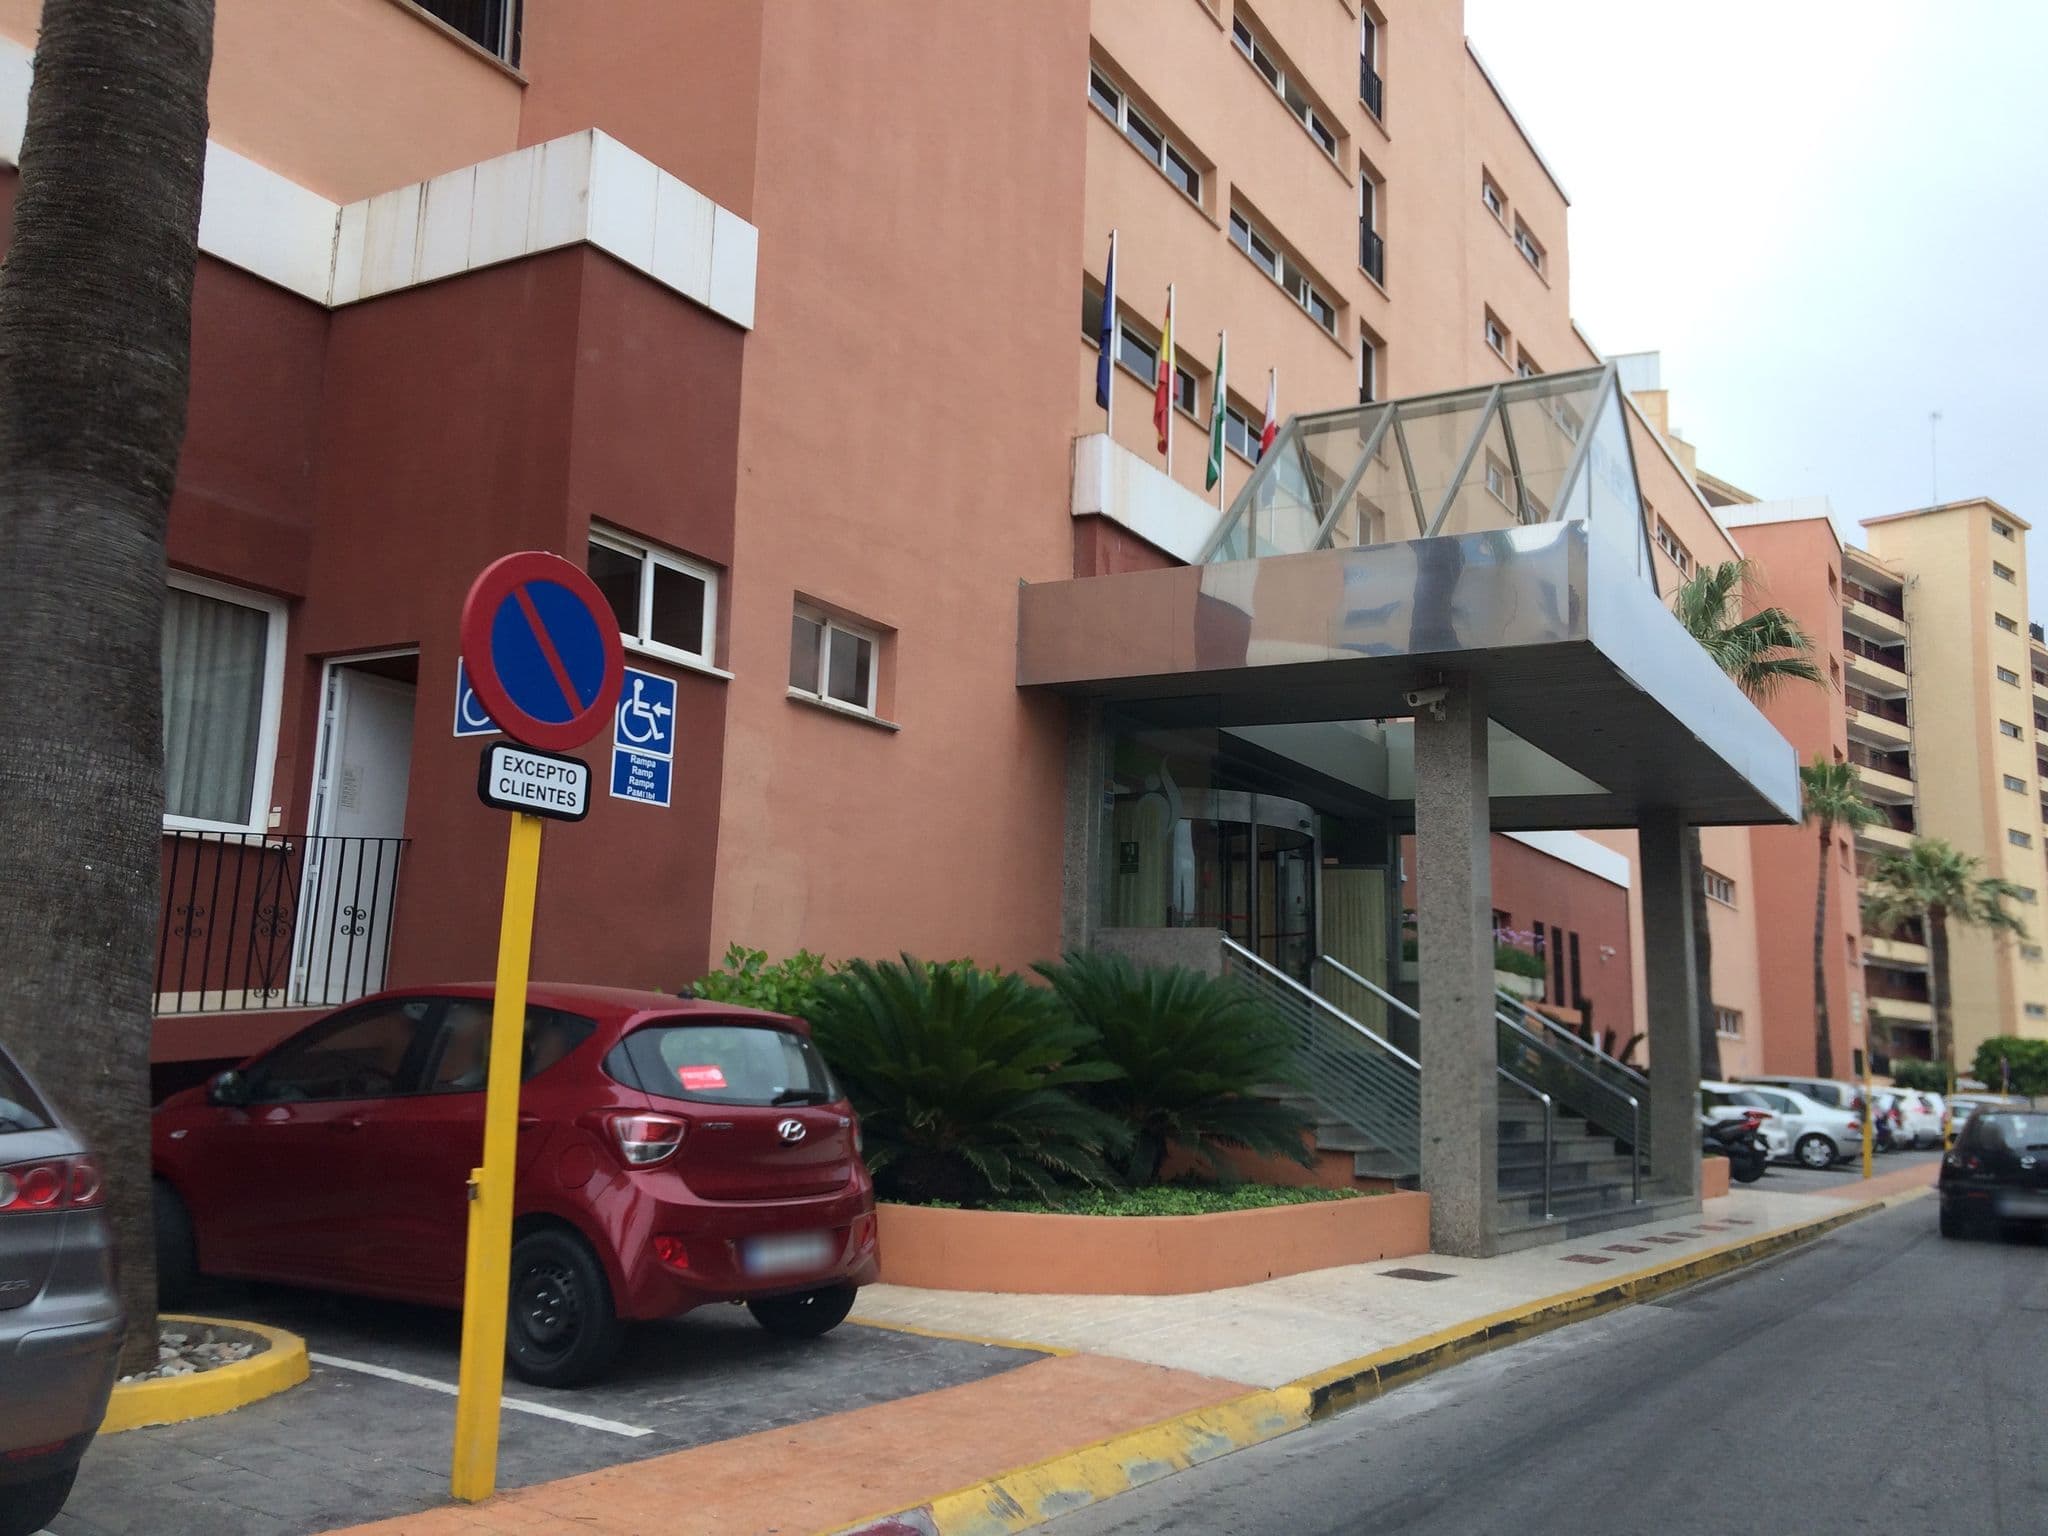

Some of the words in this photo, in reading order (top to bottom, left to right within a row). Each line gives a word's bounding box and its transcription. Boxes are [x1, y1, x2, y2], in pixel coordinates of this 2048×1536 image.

[630, 754, 656, 768] Rampa
[503, 755, 577, 785] EXCEPTO
[631, 765, 654, 779] Ramp
[629, 775, 655, 789] Rampe
[499, 778, 577, 807] CLIENTES
